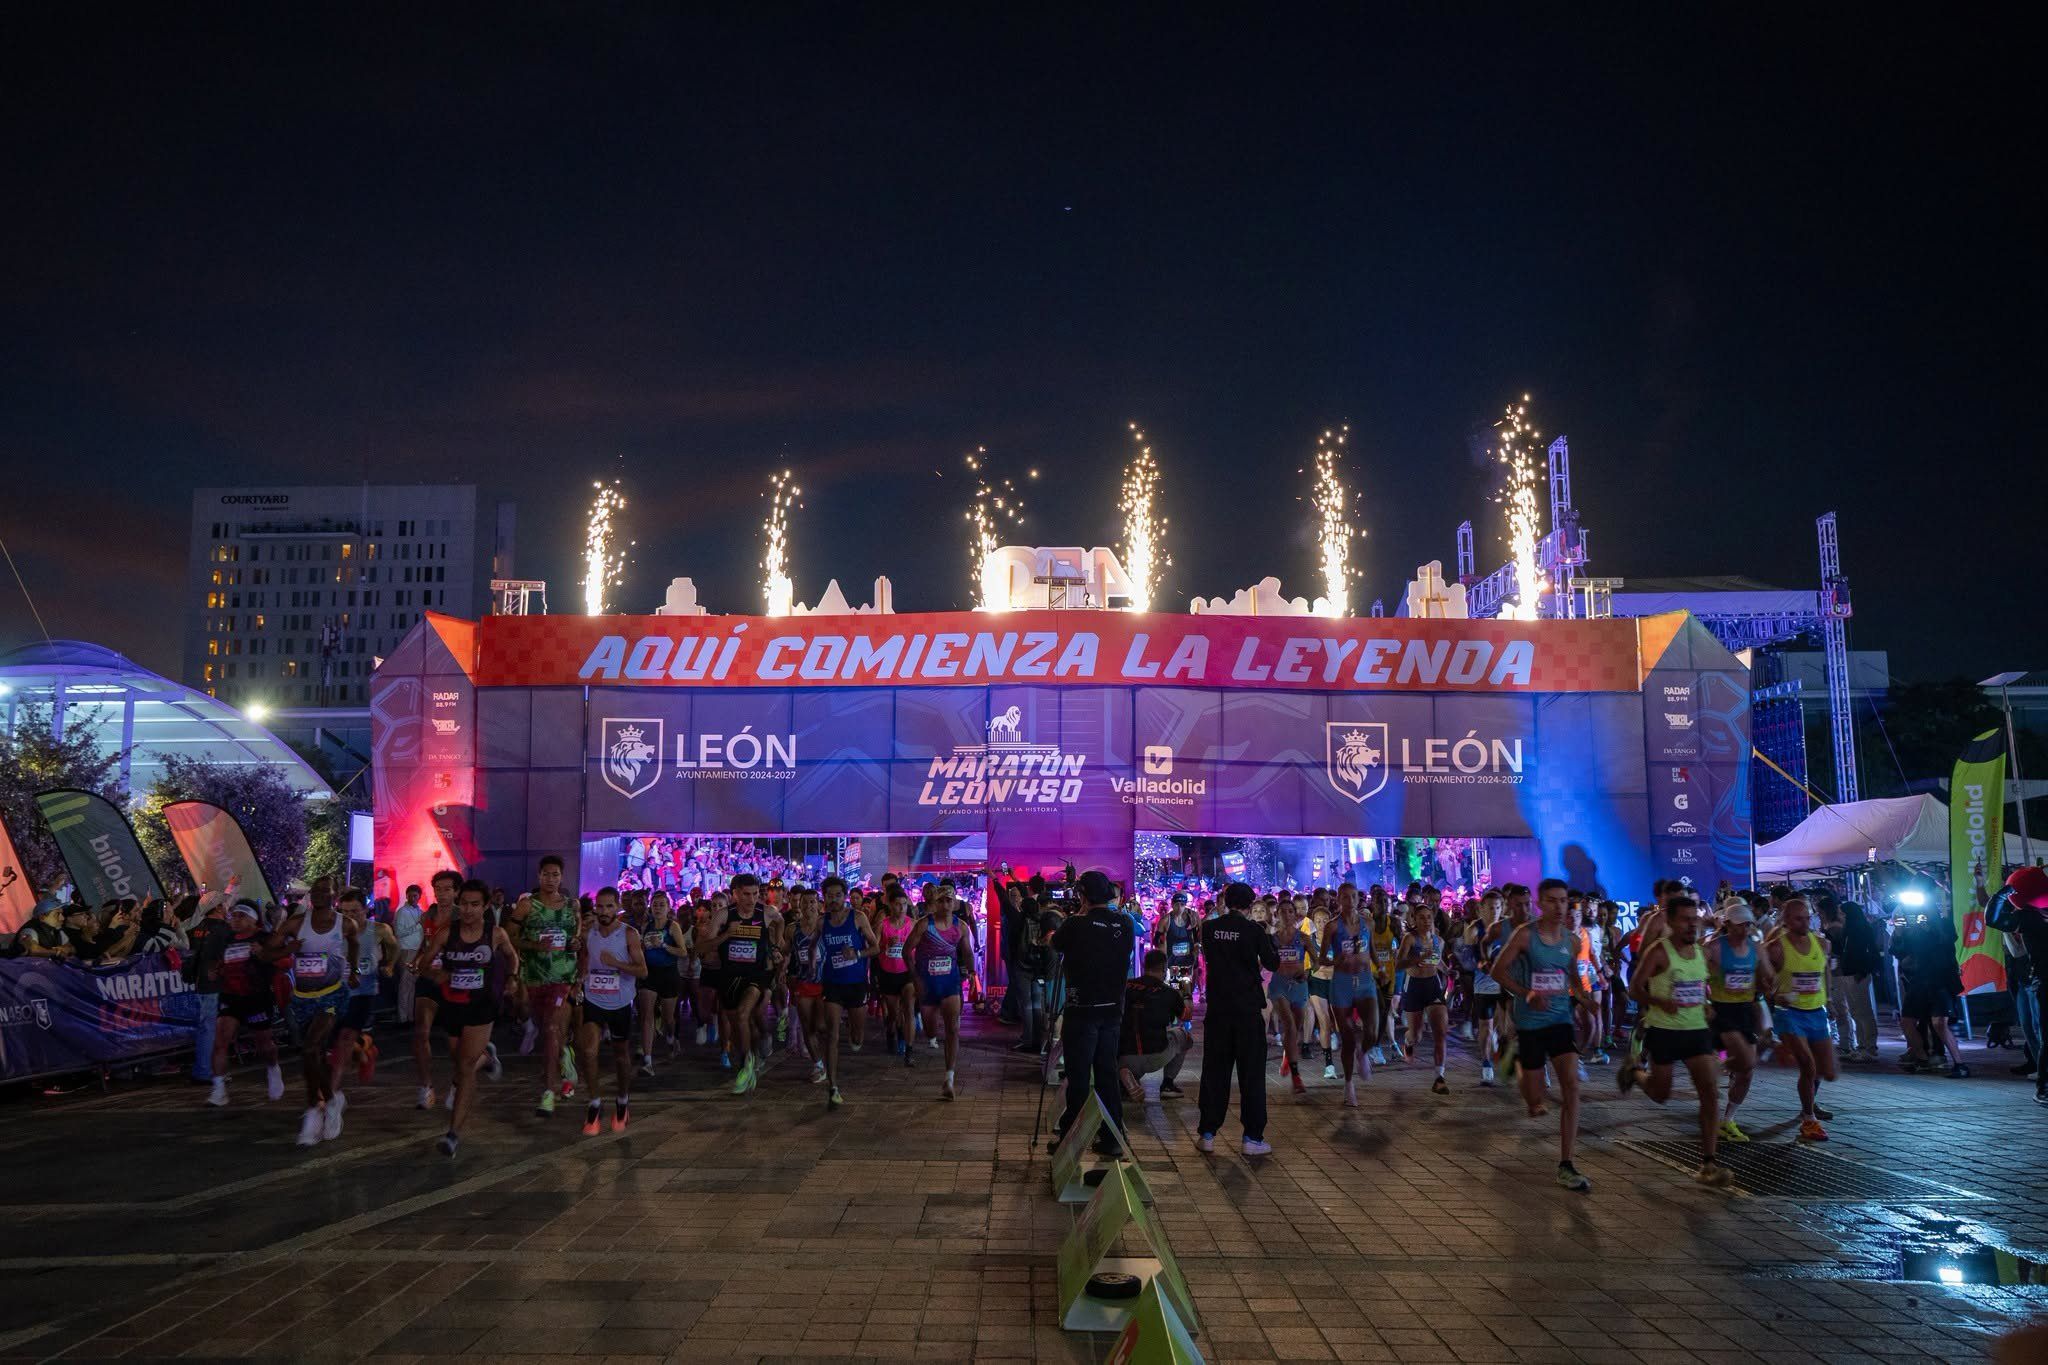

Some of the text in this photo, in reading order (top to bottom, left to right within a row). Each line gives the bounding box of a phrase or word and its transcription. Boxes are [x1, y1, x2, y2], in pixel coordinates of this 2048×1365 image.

[221, 495, 288, 504] COURTYARD
[578, 622, 1535, 686] AQUÍ COMIENZA LA LEYENDA
[433, 692, 459, 700] RADAR
[1664, 687, 1690, 695] RADAR
[676, 725, 797, 769] LEÓN
[1402, 729, 1523, 774] LEÓN
[928, 749, 1086, 779] MARATÓN
[676, 771, 796, 779] AYUNTAMIENTO 2024-2027
[1403, 775, 1524, 784] AYUNTAMIENTO 2024-2027
[1110, 777, 1206, 795] Valladolid
[1122, 795, 1194, 806] Caja Financiera
[1213, 930, 1240, 941] STAFF
